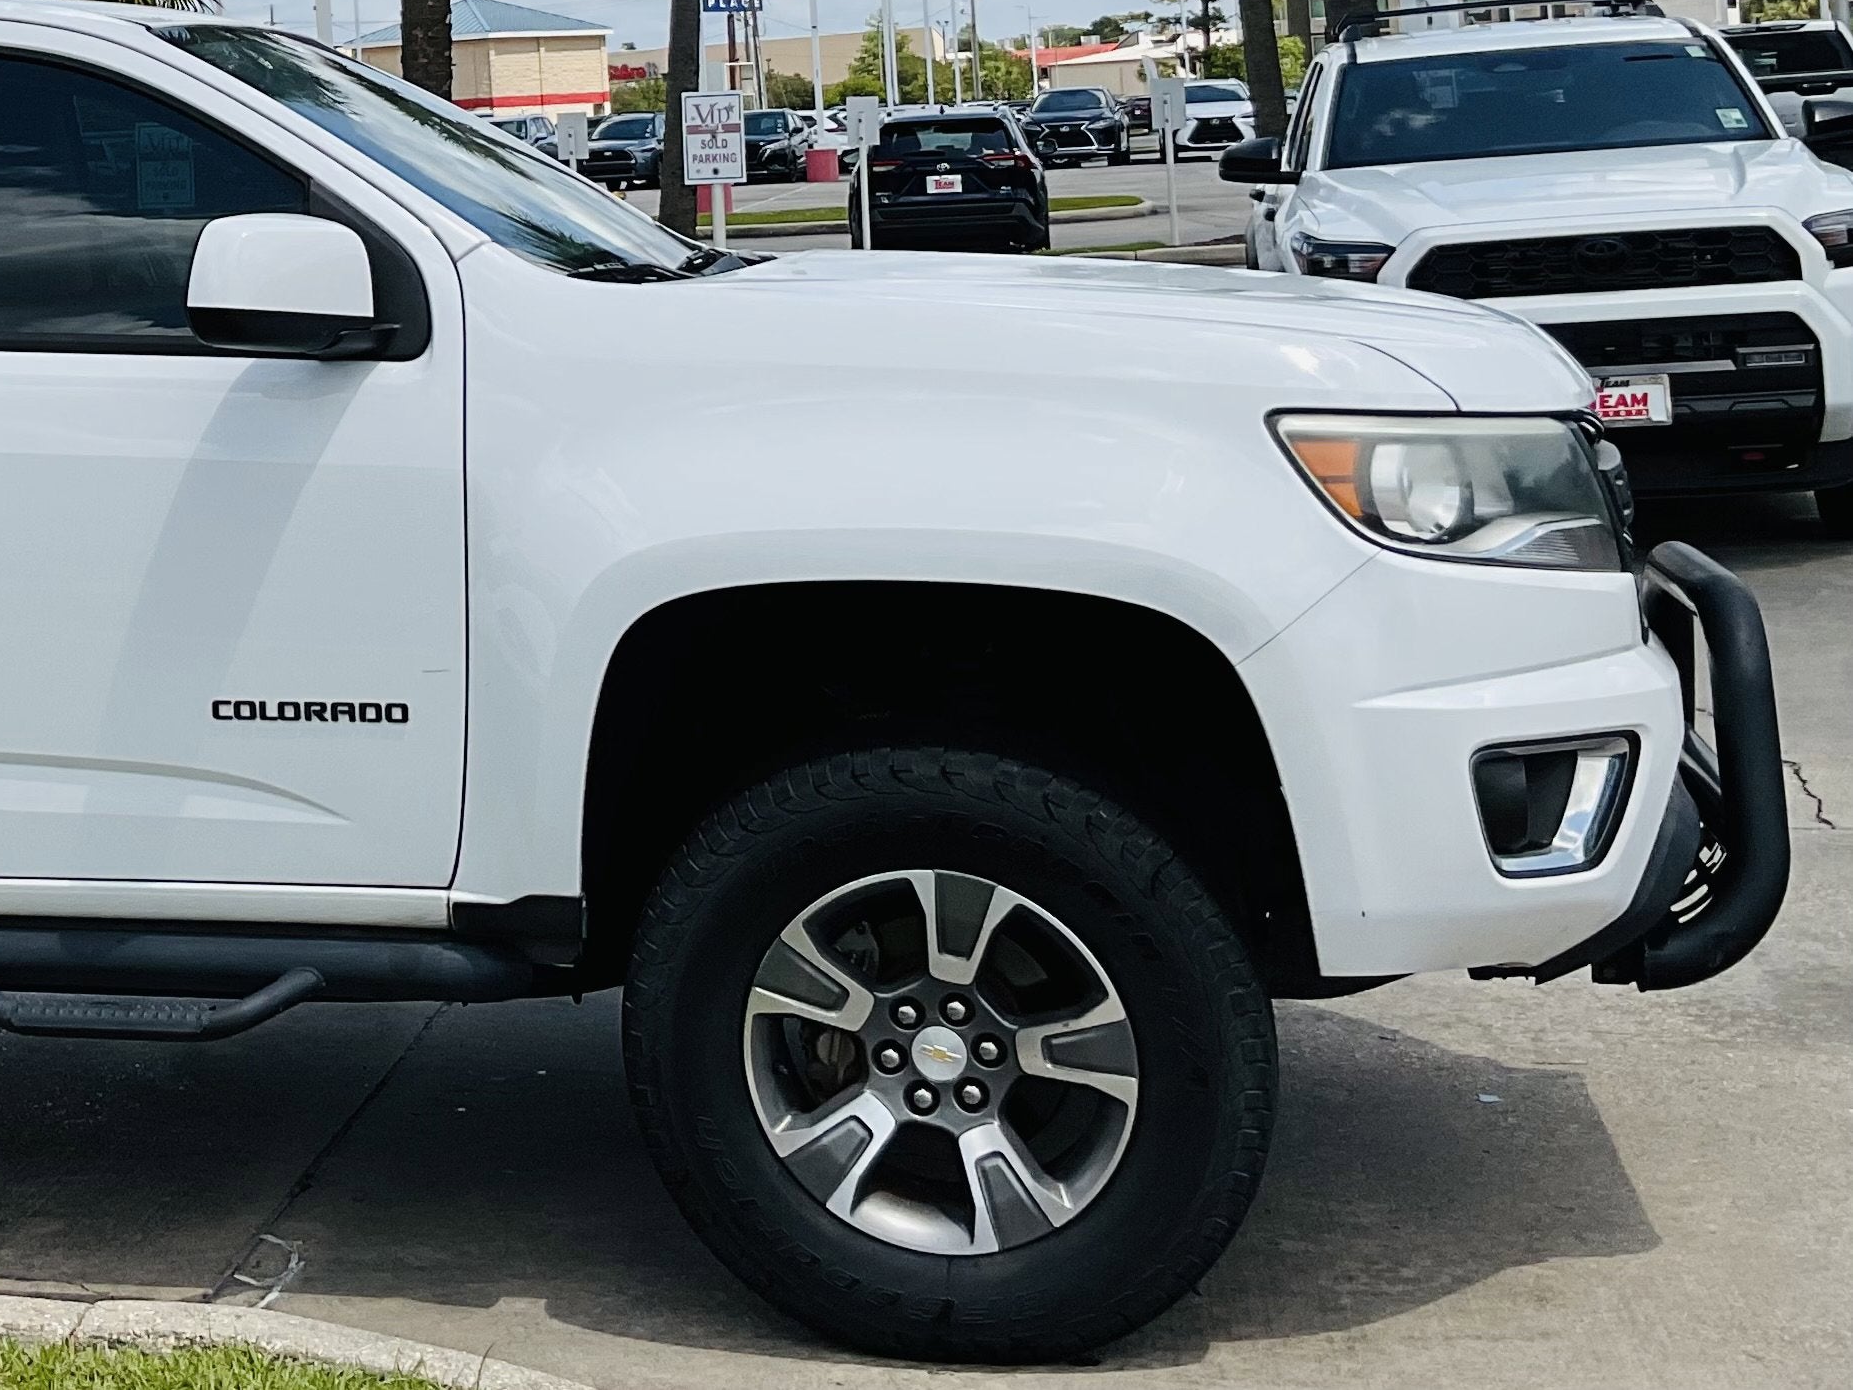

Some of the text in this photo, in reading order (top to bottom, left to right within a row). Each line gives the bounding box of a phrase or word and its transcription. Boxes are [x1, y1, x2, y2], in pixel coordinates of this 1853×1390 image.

[700, 139, 728, 149] SOLD
[692, 153, 737, 164] PARKING
[1591, 390, 1649, 409] EAM
[212, 700, 409, 723] COLORADO
